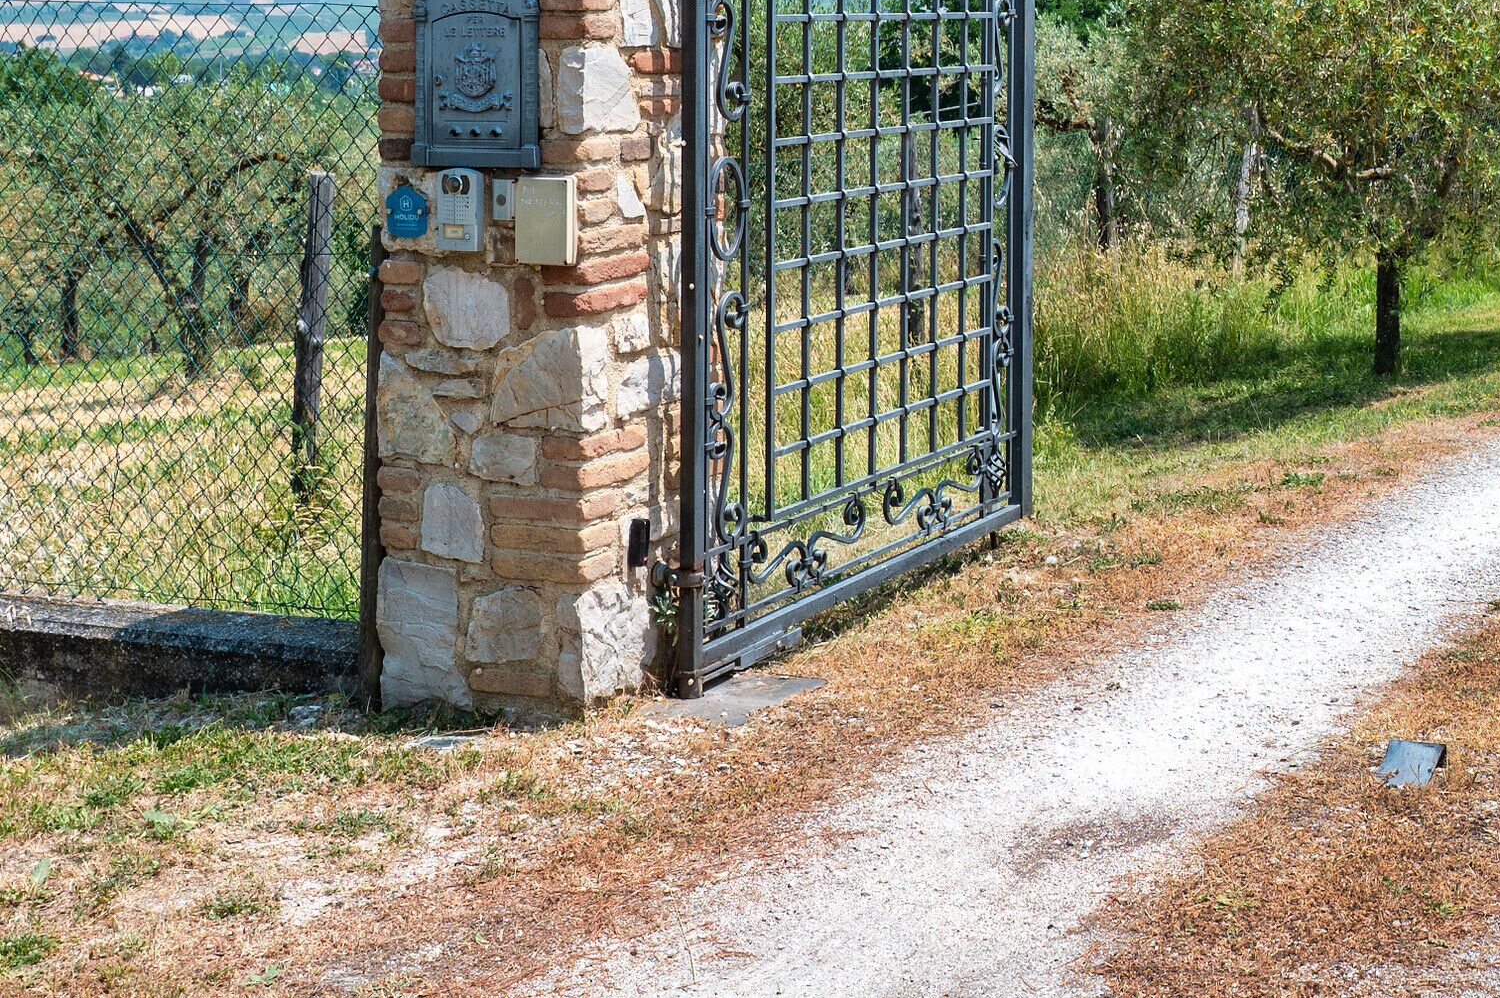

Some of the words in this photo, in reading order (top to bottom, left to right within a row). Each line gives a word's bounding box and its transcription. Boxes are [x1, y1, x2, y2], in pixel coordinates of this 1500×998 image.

[440, 0, 511, 15] CASSETTA
[466, 16, 485, 25] PER
[444, 28, 457, 38] LE
[462, 28, 506, 38] LETTERE
[394, 213, 420, 221] HOLIDU
